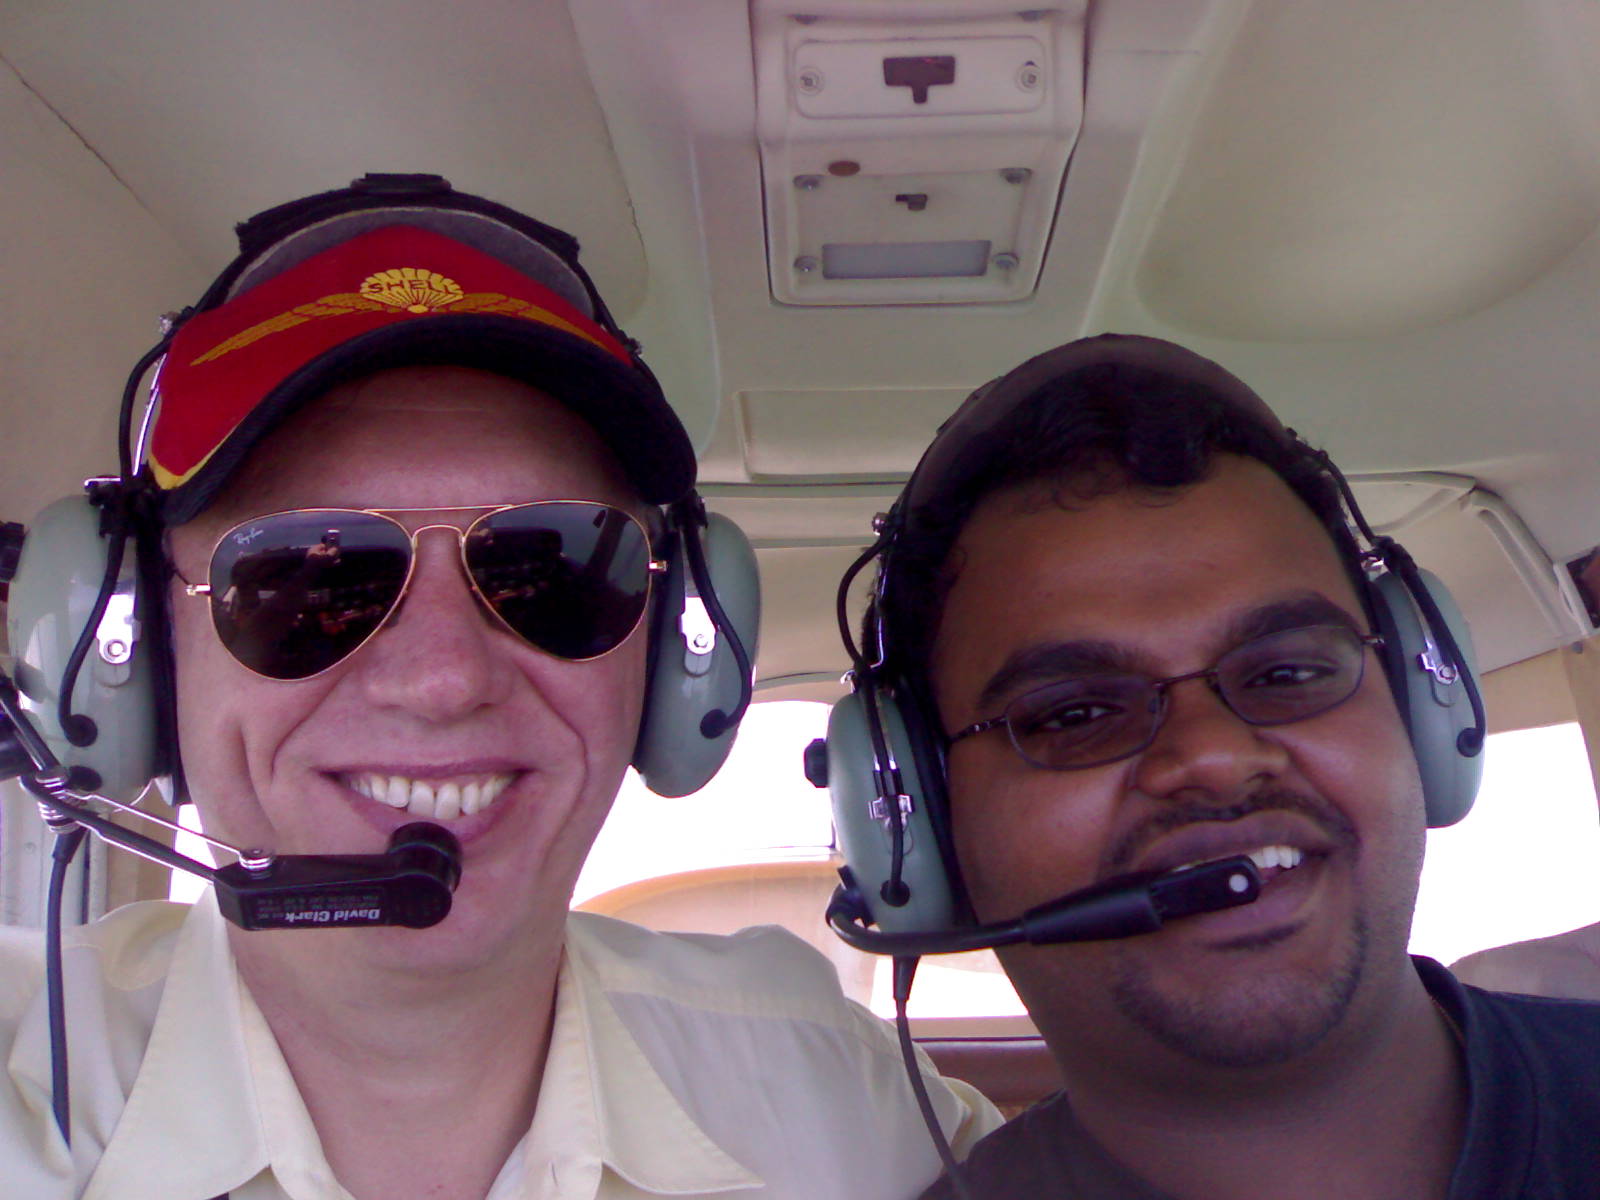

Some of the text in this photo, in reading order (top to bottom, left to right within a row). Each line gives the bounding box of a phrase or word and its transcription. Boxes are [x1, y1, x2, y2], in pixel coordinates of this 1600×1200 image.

[367, 279, 458, 296] SHELL
[285, 911, 331, 923] Clark
[333, 908, 380, 921] David
